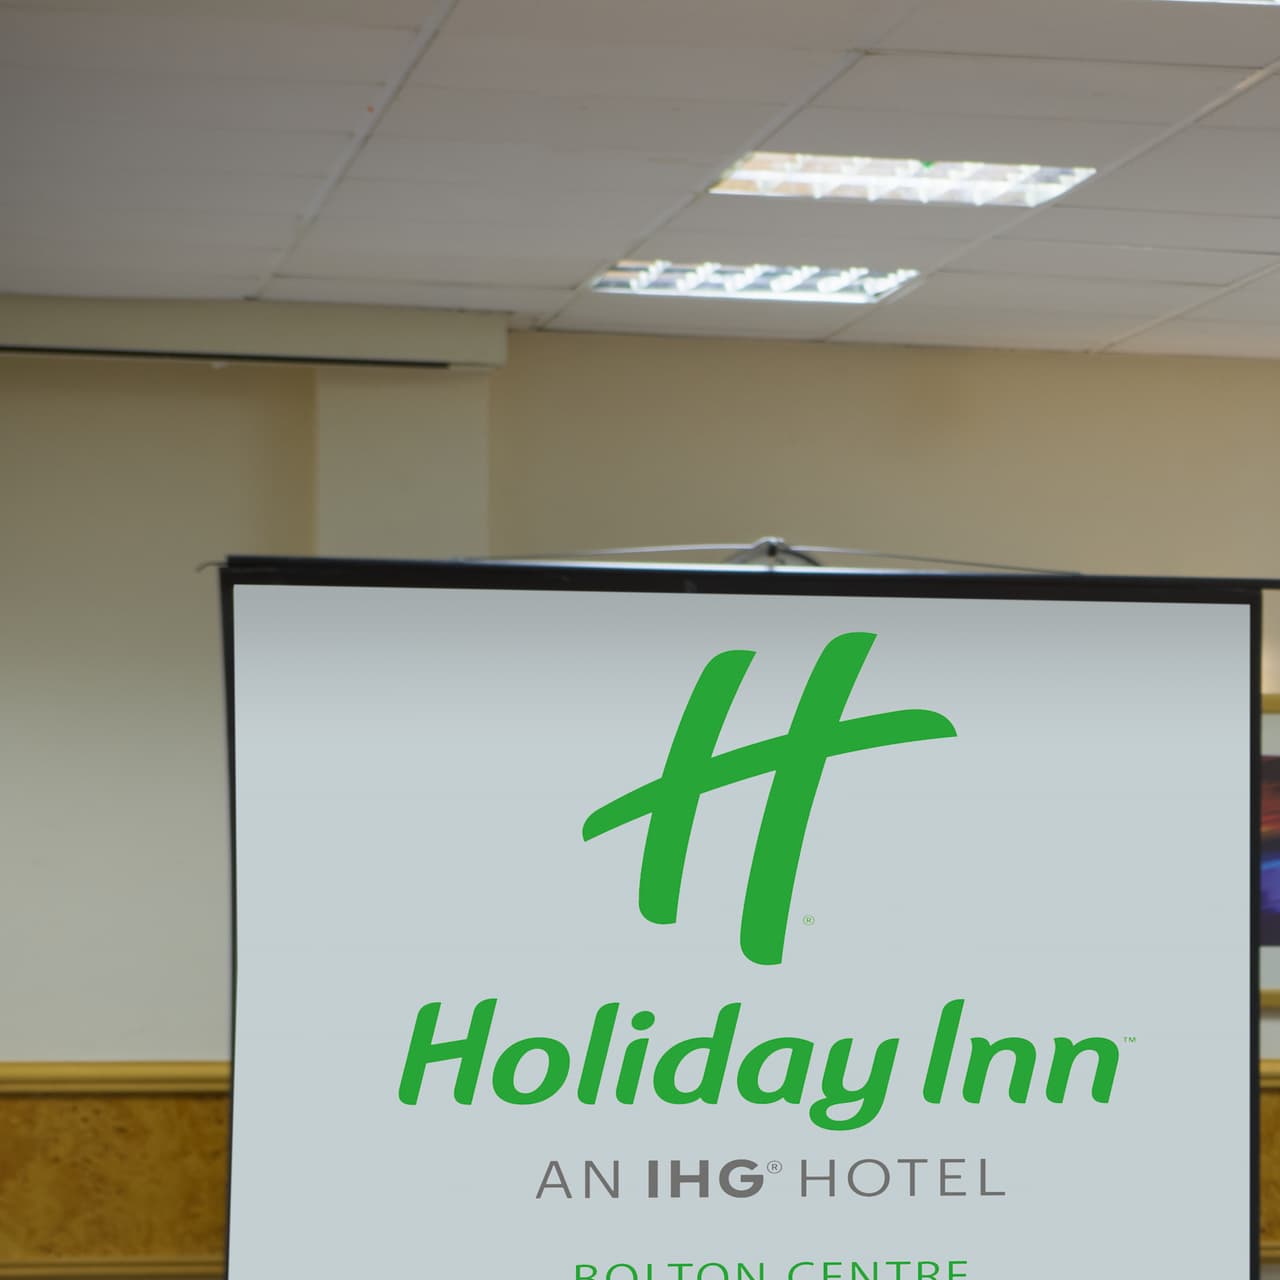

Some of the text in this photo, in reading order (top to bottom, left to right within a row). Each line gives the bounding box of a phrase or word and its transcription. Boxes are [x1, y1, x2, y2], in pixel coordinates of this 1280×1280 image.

[396, 995, 902, 1133] Holiday
[535, 1159, 620, 1200] AN
[800, 1158, 1006, 1199] HOTEL
